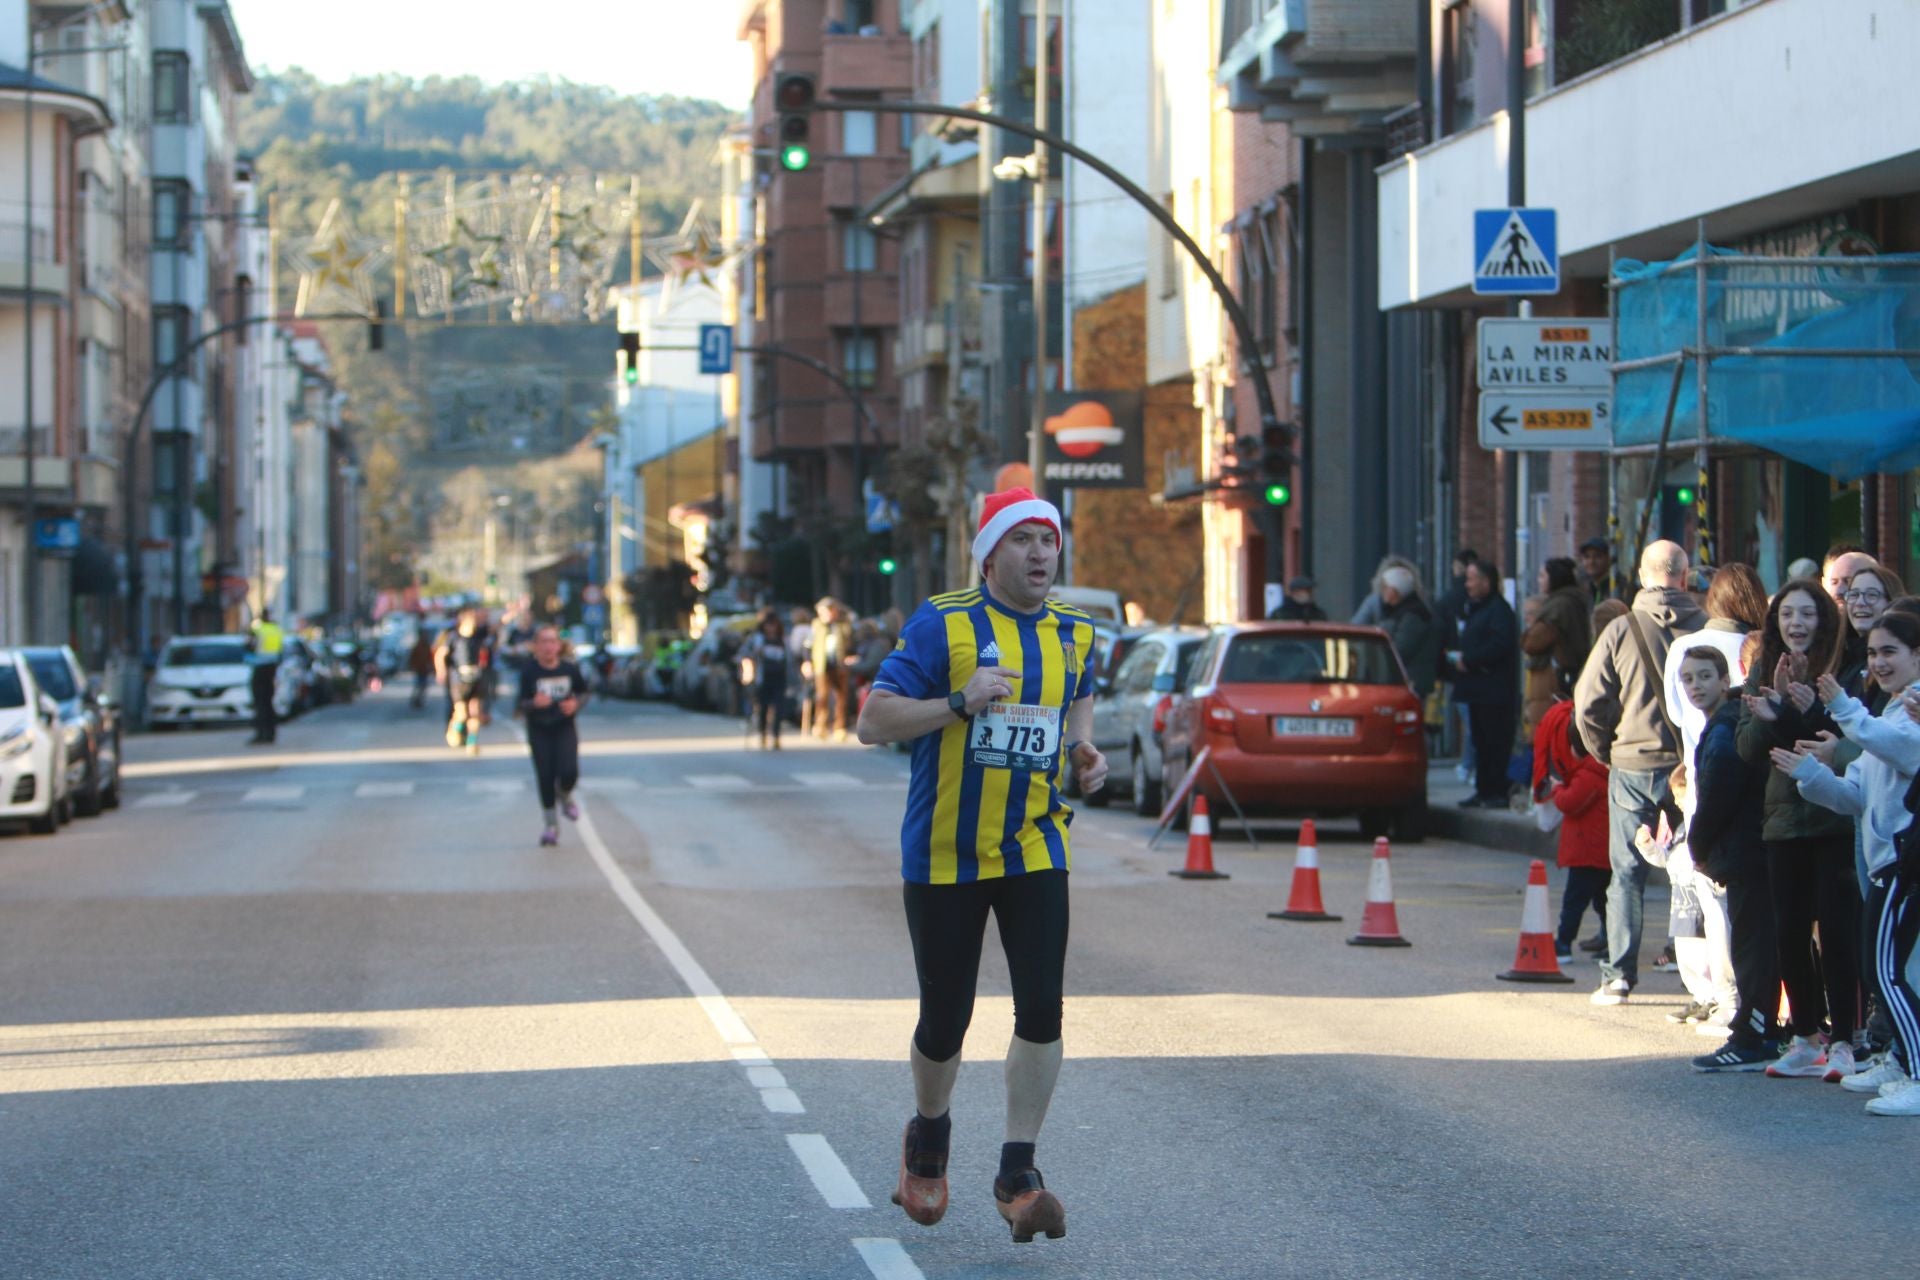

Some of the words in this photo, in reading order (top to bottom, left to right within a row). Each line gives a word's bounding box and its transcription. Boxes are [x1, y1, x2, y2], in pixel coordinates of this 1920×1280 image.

[1487, 347, 1514, 361] LA
[1534, 347, 1610, 362] MIRAN
[1489, 367, 1567, 383] AVILES
[1526, 412, 1589, 426] AS-373
[1045, 463, 1123, 479] REPSOL
[990, 704, 1006, 714] SAN
[1010, 705, 1048, 717] SILVESTRE
[1007, 726, 1046, 753] 773
